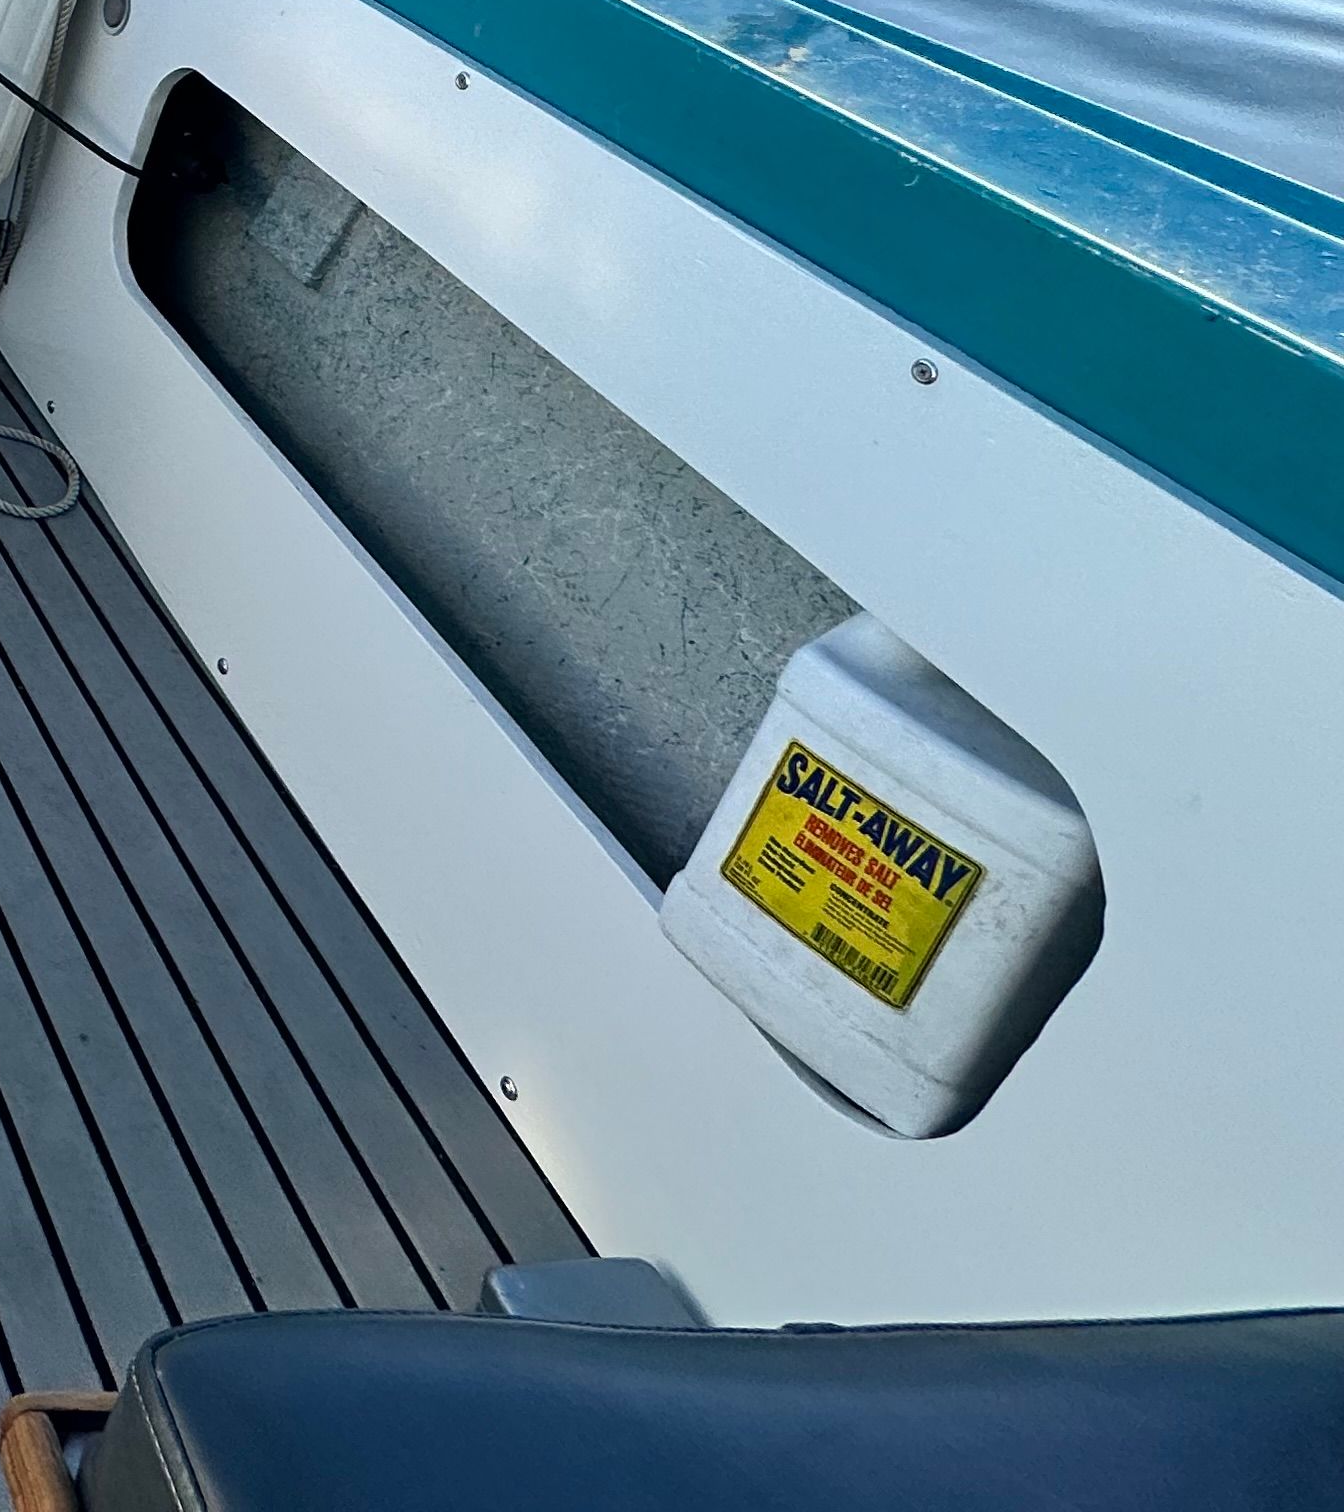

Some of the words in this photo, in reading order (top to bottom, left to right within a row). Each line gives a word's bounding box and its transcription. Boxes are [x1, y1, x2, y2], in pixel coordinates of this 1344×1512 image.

[776, 752, 971, 901] SALT-AWAY
[804, 813, 865, 867] REMOVES
[864, 857, 901, 890] SALT
[855, 877, 875, 898] DE
[871, 889, 893, 913] SEL
